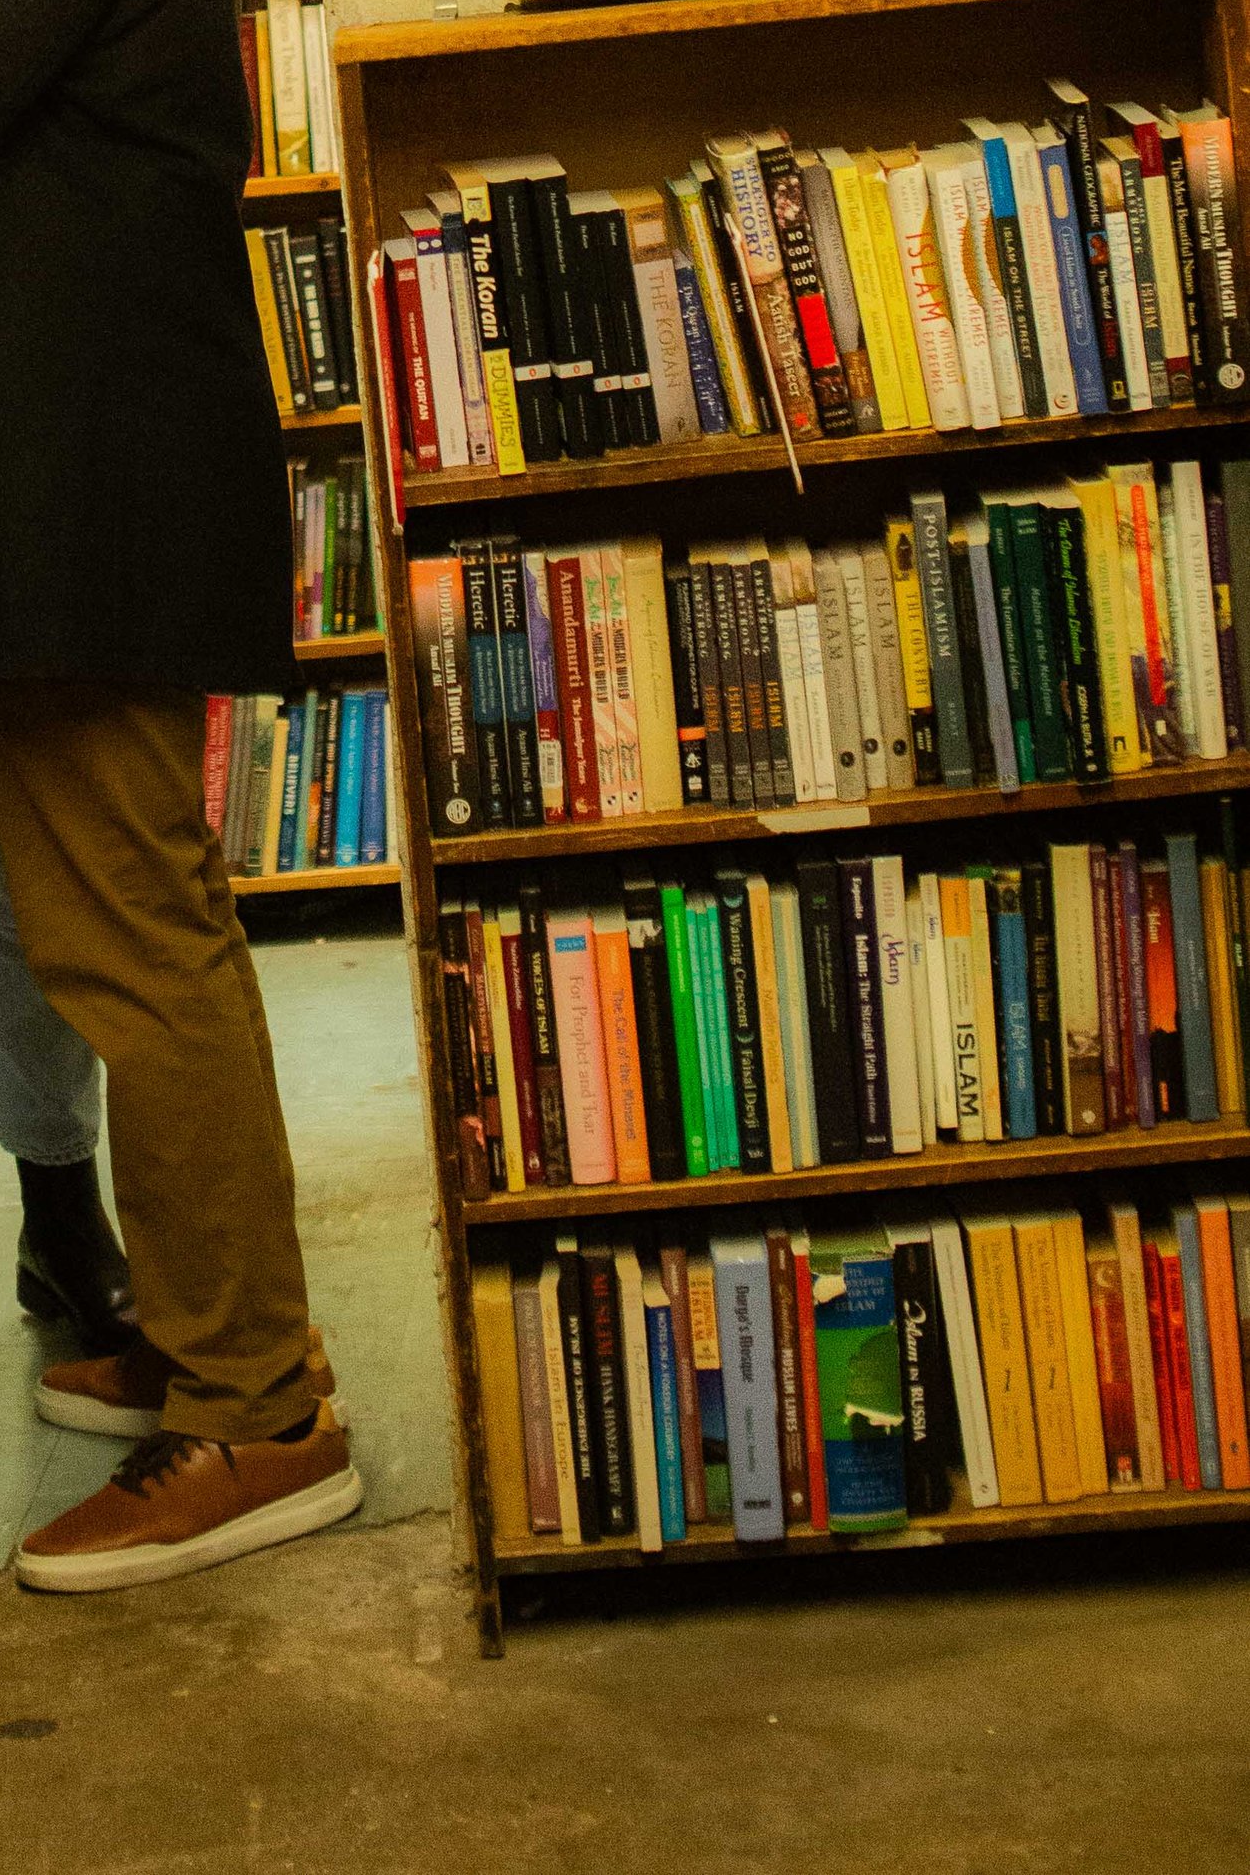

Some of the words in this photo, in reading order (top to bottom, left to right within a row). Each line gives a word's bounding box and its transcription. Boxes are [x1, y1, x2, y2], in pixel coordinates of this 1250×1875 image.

[1076, 115, 1093, 162] NATIONAL
[1170, 157, 1184, 180] The
[729, 168, 763, 260] HISTORY
[746, 155, 772, 238] STRANGER
[764, 242, 777, 262] TO
[950, 184, 966, 220] ISLAM
[973, 176, 988, 212] ISLAM
[1083, 164, 1100, 226] GEOGRAPHIC
[1123, 169, 1143, 255] ARMSTRONG
[1172, 181, 1187, 206] Most
[787, 230, 804, 242] NO
[1175, 208, 1193, 258] Beautiful
[1198, 207, 1210, 232] Ausaf
[470, 234, 493, 272] The
[787, 244, 810, 257] GOD
[1003, 226, 1015, 263] ISLAM
[1201, 234, 1211, 250] Ali
[791, 259, 814, 272] BUT
[794, 274, 817, 287] GOD
[905, 231, 945, 322] ISLAM
[1008, 266, 1019, 284] ON
[1097, 268, 1108, 283] The
[1181, 260, 1196, 295] Names
[476, 277, 499, 338] Koran
[650, 270, 669, 313] THE
[729, 281, 744, 313] ISLAM
[1013, 289, 1023, 311] THE
[1099, 284, 1111, 307] World
[655, 317, 682, 390] KORAN
[765, 293, 790, 345] Aatish
[781, 348, 801, 397] Taseer
[939, 327, 959, 386] WITHOUT
[1017, 315, 1032, 360] STREET
[923, 331, 945, 394] EXTREMES
[490, 366, 517, 448] DUMMIES
[1191, 533, 1203, 548] IN
[922, 513, 951, 657] POST-ISLAMISM
[1192, 554, 1206, 582] THE
[437, 573, 455, 636] MODERN
[735, 571, 751, 656] ARMSTRONG
[753, 569, 770, 654] ARMSTRONG
[846, 575, 866, 648] ISLAM
[874, 576, 896, 649] ISLAM
[905, 591, 922, 622] THE
[1001, 586, 1012, 604] The
[715, 574, 731, 660] ARMSTRONG
[822, 587, 844, 661] ISLAM
[1003, 605, 1017, 652] Formation
[430, 644, 442, 671] Ausaf
[443, 638, 458, 684] MUSLIM
[912, 628, 928, 696] CONVERT
[1199, 644, 1212, 660] OF
[432, 672, 443, 687] Ali
[469, 571, 486, 630] Heretic
[491, 781, 501, 795] Ali
[501, 569, 519, 628] Heretic
[522, 779, 532, 793] Ali
[559, 570, 584, 688] Anandamurti
[572, 698, 581, 713] The
[577, 760, 588, 784] Years
[1009, 665, 1021, 690] Islam
[1203, 667, 1215, 698] WAR
[447, 684, 466, 755] THOUGHT
[283, 754, 299, 815] BELIEVERS
[851, 876, 863, 919] Esposito
[728, 912, 746, 965] Waning
[1147, 910, 1160, 943] Islam
[531, 951, 543, 995] VOICES
[854, 934, 870, 977] Islam:
[881, 933, 905, 986] Islam
[535, 997, 546, 1014] OF
[568, 975, 585, 1001] For
[612, 988, 626, 1013] The
[733, 967, 749, 1028] Crescent
[858, 981, 872, 1002] The
[537, 1016, 550, 1054] ISLAM
[570, 1005, 592, 1066] Prophet
[614, 1017, 628, 1043] Call
[859, 1004, 875, 1050] Straight
[1136, 1009, 1148, 1035] Islam
[482, 1054, 494, 1085] ISLAM
[618, 1047, 630, 1062] of
[620, 1065, 633, 1085] the
[740, 1048, 756, 1090] Faisal
[864, 1053, 877, 1081] Path
[955, 1023, 979, 1117] ISLAM
[577, 1070, 593, 1099] and
[582, 1104, 597, 1135] Tsar
[620, 1089, 638, 1141] Minaret
[743, 1093, 760, 1129] Devji
[656, 1312, 668, 1339] NOTES
[735, 1285, 751, 1332] Durga's
[568, 1316, 580, 1356] ISLAM
[660, 1341, 671, 1356] ON
[903, 1300, 927, 1362] Islam
[549, 1346, 565, 1393] Islam
[572, 1358, 581, 1376] OF
[737, 1335, 753, 1383] Mosque
[781, 1348, 794, 1394] MUSLIM
[909, 1367, 918, 1381] IN
[600, 1365, 614, 1404] HANK
[660, 1372, 672, 1413] FOREIGN
[553, 1398, 565, 1415] in
[574, 1378, 589, 1451] EMERGENCE
[783, 1397, 798, 1432] LIVES
[910, 1385, 926, 1442] RUSSIA
[555, 1421, 570, 1480] Europe
[663, 1415, 675, 1461] COUNTRY
[581, 1455, 591, 1479] THE
